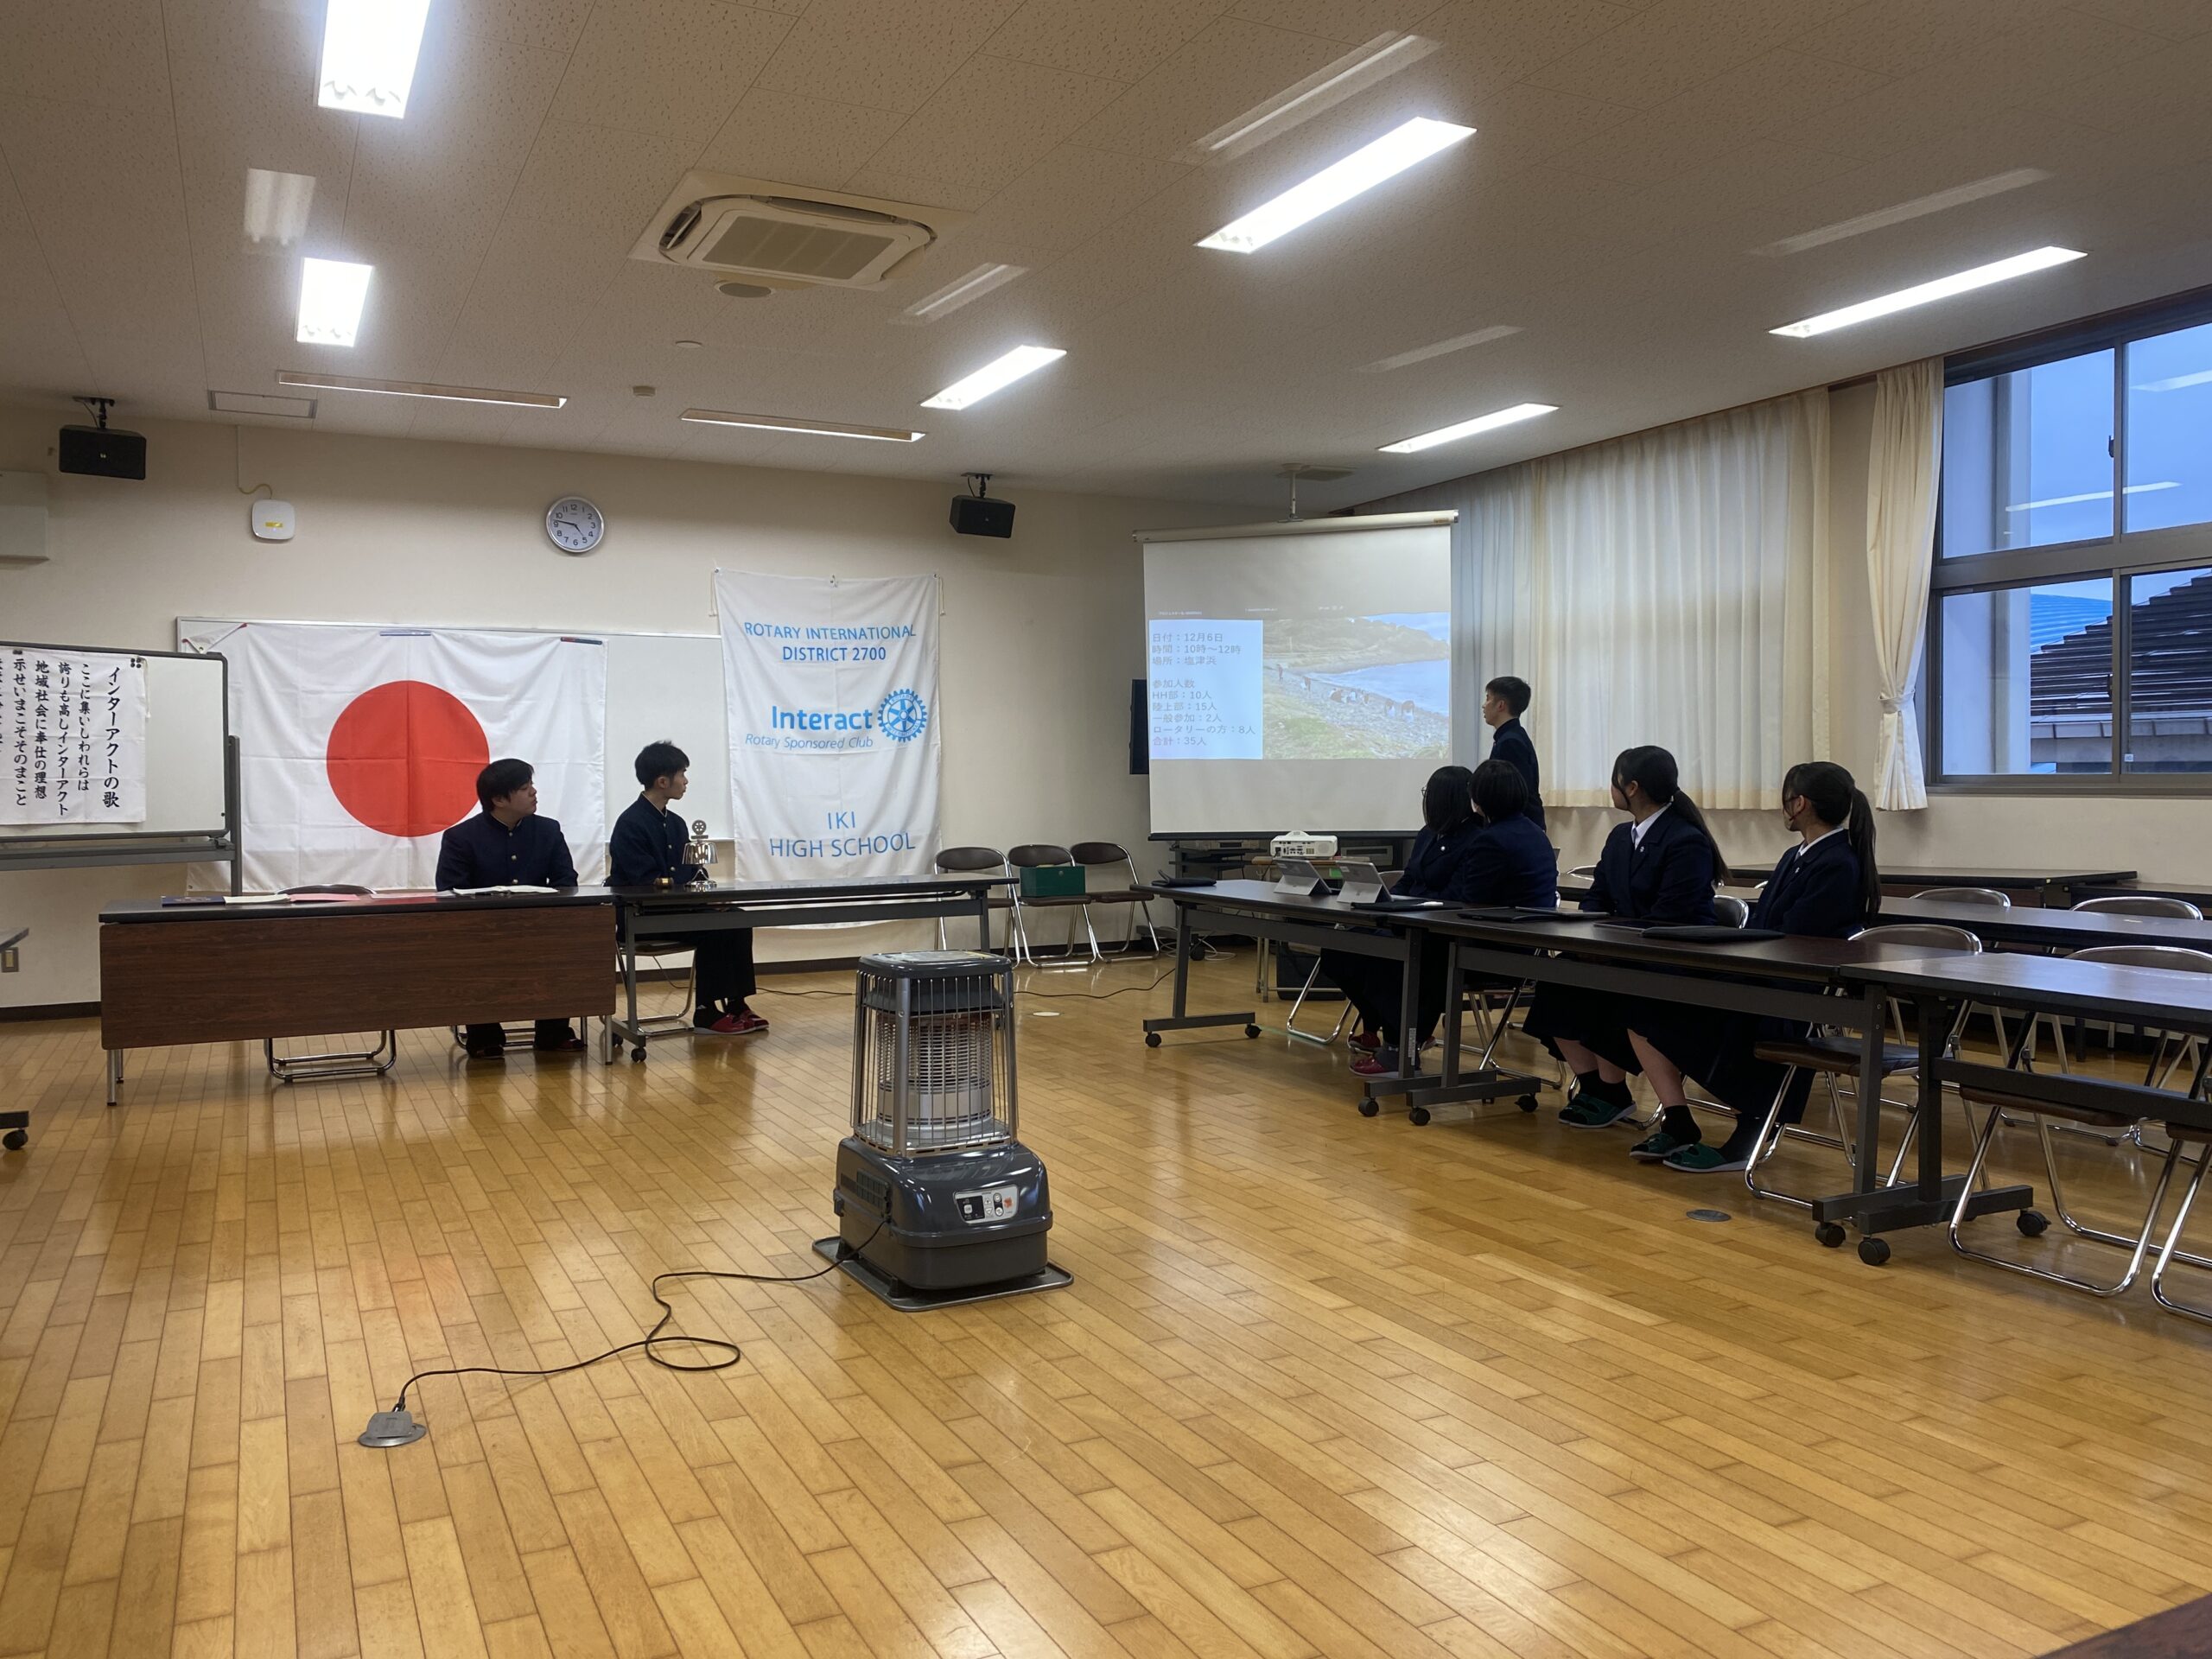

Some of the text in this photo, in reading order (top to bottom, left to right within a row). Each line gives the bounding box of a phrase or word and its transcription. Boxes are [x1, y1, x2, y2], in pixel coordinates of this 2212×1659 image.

[745, 621, 916, 640] ROTARY INTERNATIONAL
[782, 646, 887, 661] DISTRICT 2700
[35, 660, 49, 800] 地域社会に奉仕の理想
[77, 664, 91, 791] ここに集いしわれらは
[772, 705, 873, 730] Interact
[56, 662, 72, 817] 誇りも高しインターアクト
[102, 666, 120, 808] インターアクトの歌
[745, 734, 873, 751] Rotary Sponsored Club
[827, 811, 856, 830] IKI
[770, 832, 916, 858] HIGH SCHOOL
